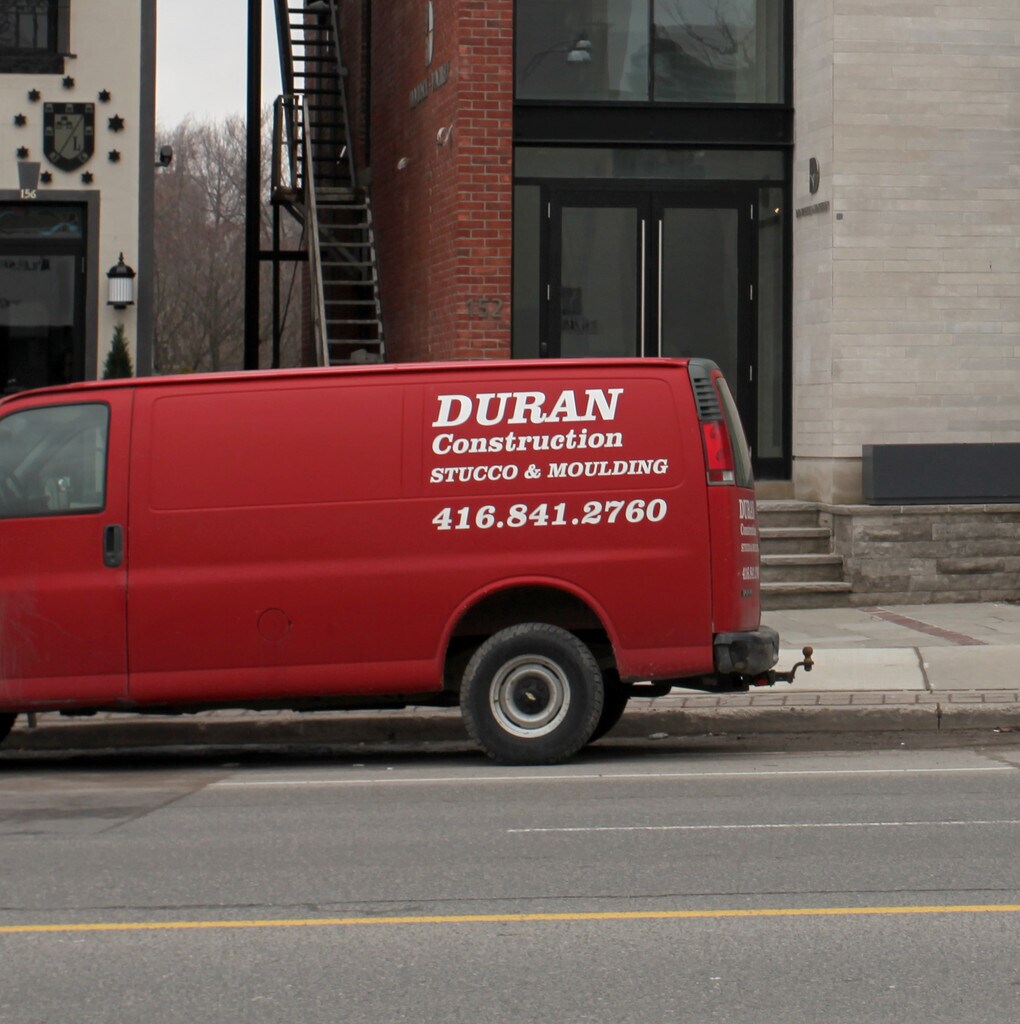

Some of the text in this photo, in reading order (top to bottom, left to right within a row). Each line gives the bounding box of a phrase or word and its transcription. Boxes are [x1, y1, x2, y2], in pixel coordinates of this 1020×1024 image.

[19, 188, 37, 200] 156
[467, 298, 502, 318] 152
[431, 387, 624, 428] DURAN
[431, 428, 623, 455] Construction
[429, 458, 670, 483] STUCCO & MOULDING
[431, 498, 668, 531] 416.841.2760
